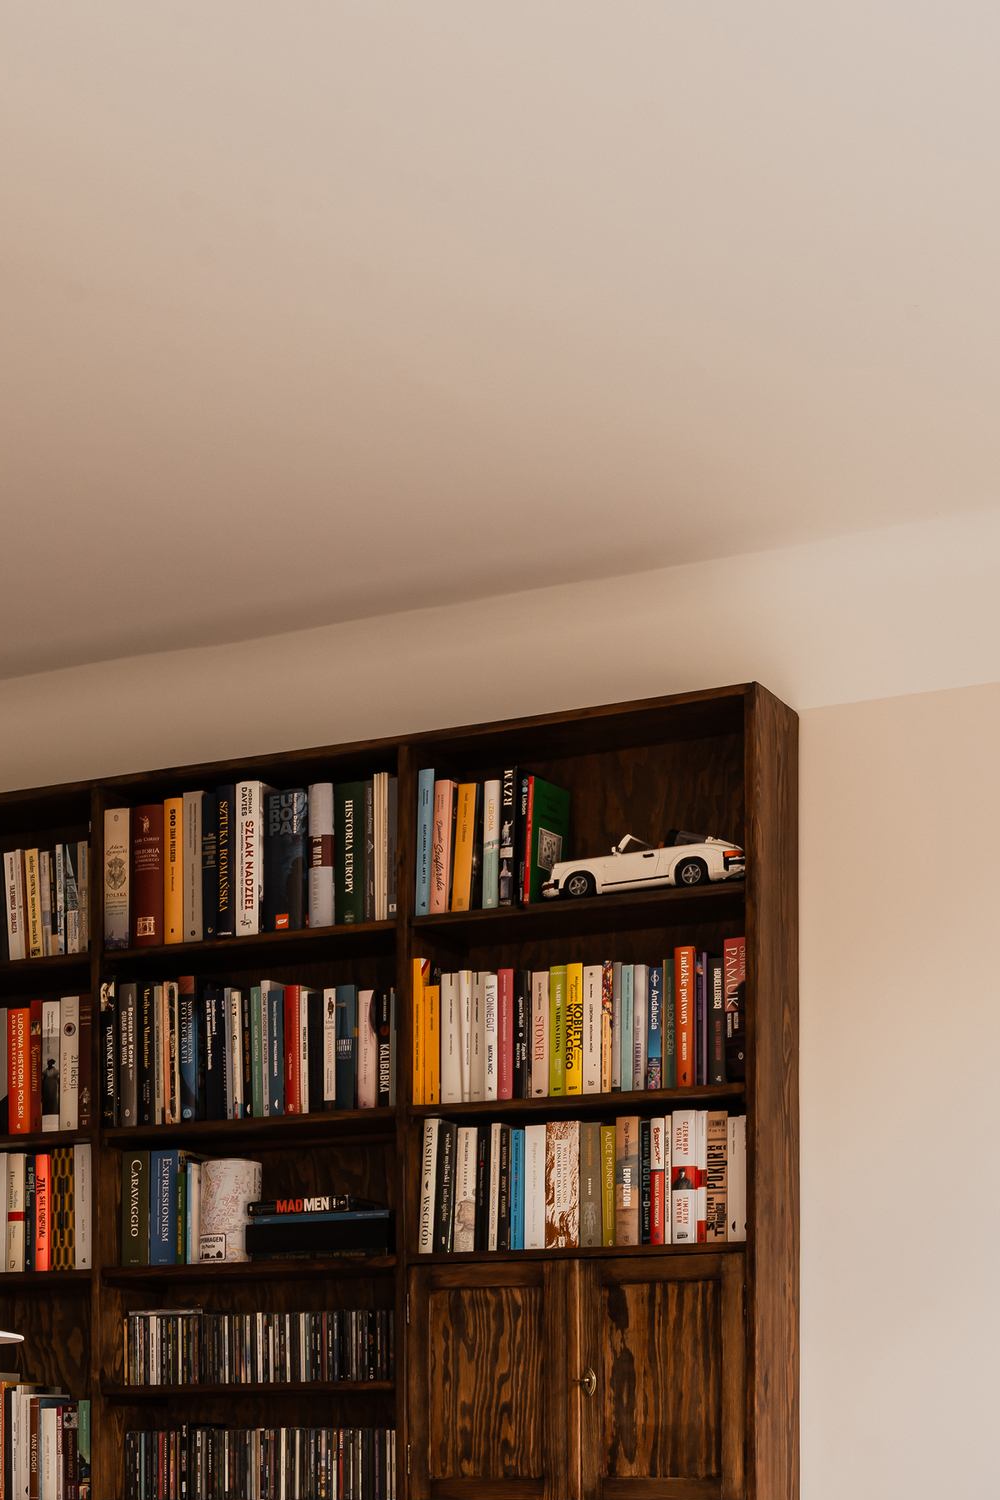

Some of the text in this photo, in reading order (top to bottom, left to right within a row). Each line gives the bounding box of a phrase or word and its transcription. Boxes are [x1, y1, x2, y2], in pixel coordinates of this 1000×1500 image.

[503, 769, 513, 806] RZYM
[219, 801, 230, 912] SZTUKA ROMAŃSKA
[245, 821, 254, 910] SZLAK NADZIEI
[345, 800, 354, 894] HISTORIA EUROPY
[680, 951, 689, 1026] Ludzkie potwory
[712, 968, 722, 1009] HOUELLEBECQ
[725, 947, 738, 1009] PAMUK
[486, 992, 494, 1032] VONNEGUT
[574, 1003, 582, 1050] KOBIETY
[651, 989, 659, 1030] Andalucía
[535, 1016, 544, 1061] STONER
[70, 1055, 79, 1090] 21 lekcji
[380, 1044, 389, 1093] KALIBABKA
[130, 1159, 142, 1237] CARAVAGGIO
[161, 1157, 172, 1242] EXPRESSIONISM
[421, 1127, 433, 1246] STASIUK WSCHÓD
[557, 1180, 561, 1188] DA
